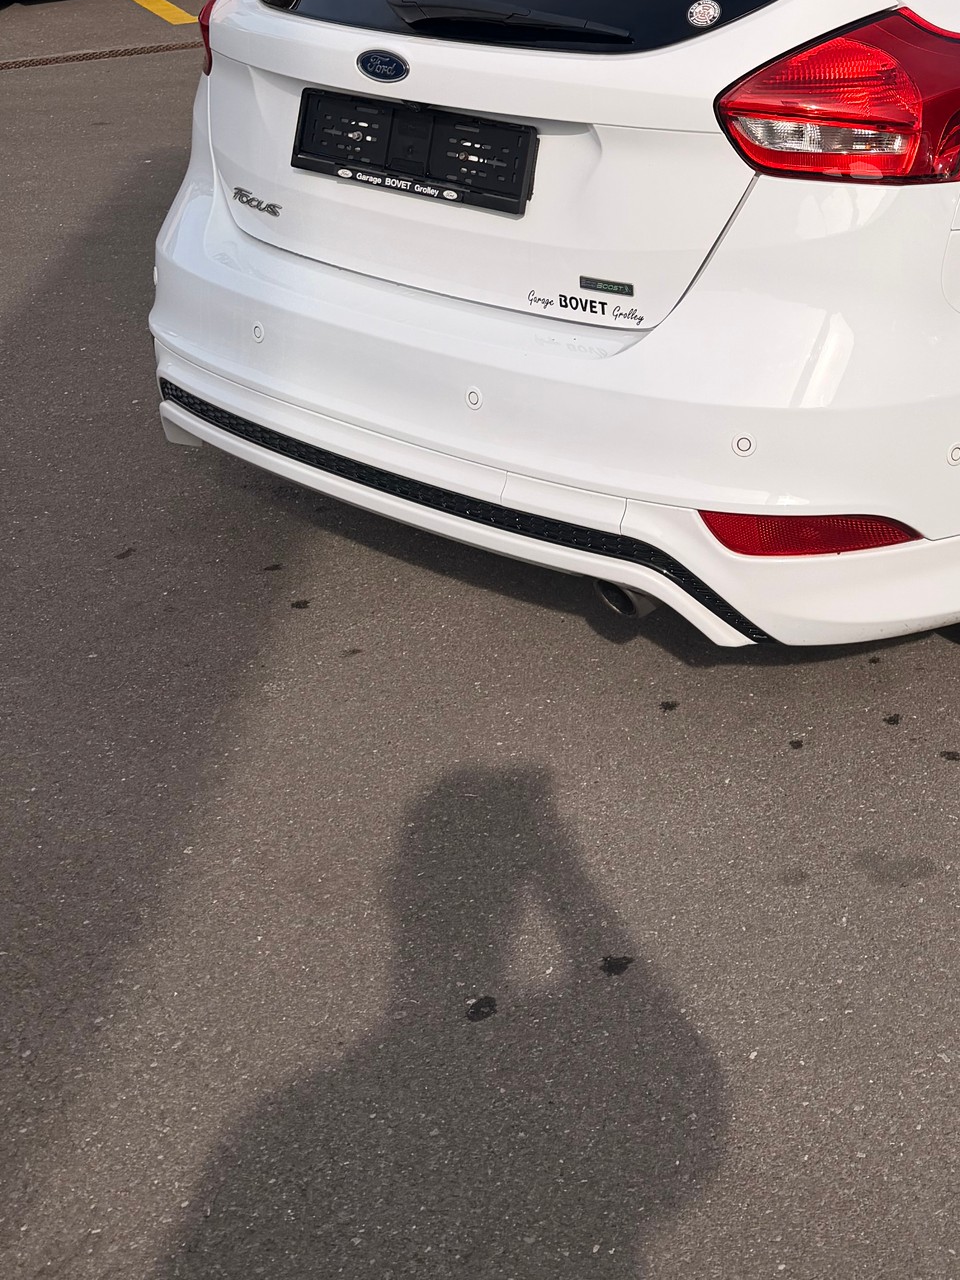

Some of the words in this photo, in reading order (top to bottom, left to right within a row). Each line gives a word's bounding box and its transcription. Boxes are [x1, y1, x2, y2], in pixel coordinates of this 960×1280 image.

[367, 55, 397, 76] Ford
[356, 172, 382, 185] Garage
[385, 177, 411, 190] BOVET
[414, 184, 439, 197] Grolley
[528, 289, 554, 309] Garage
[558, 294, 607, 315] BOVET
[612, 306, 644, 325] Grolley
